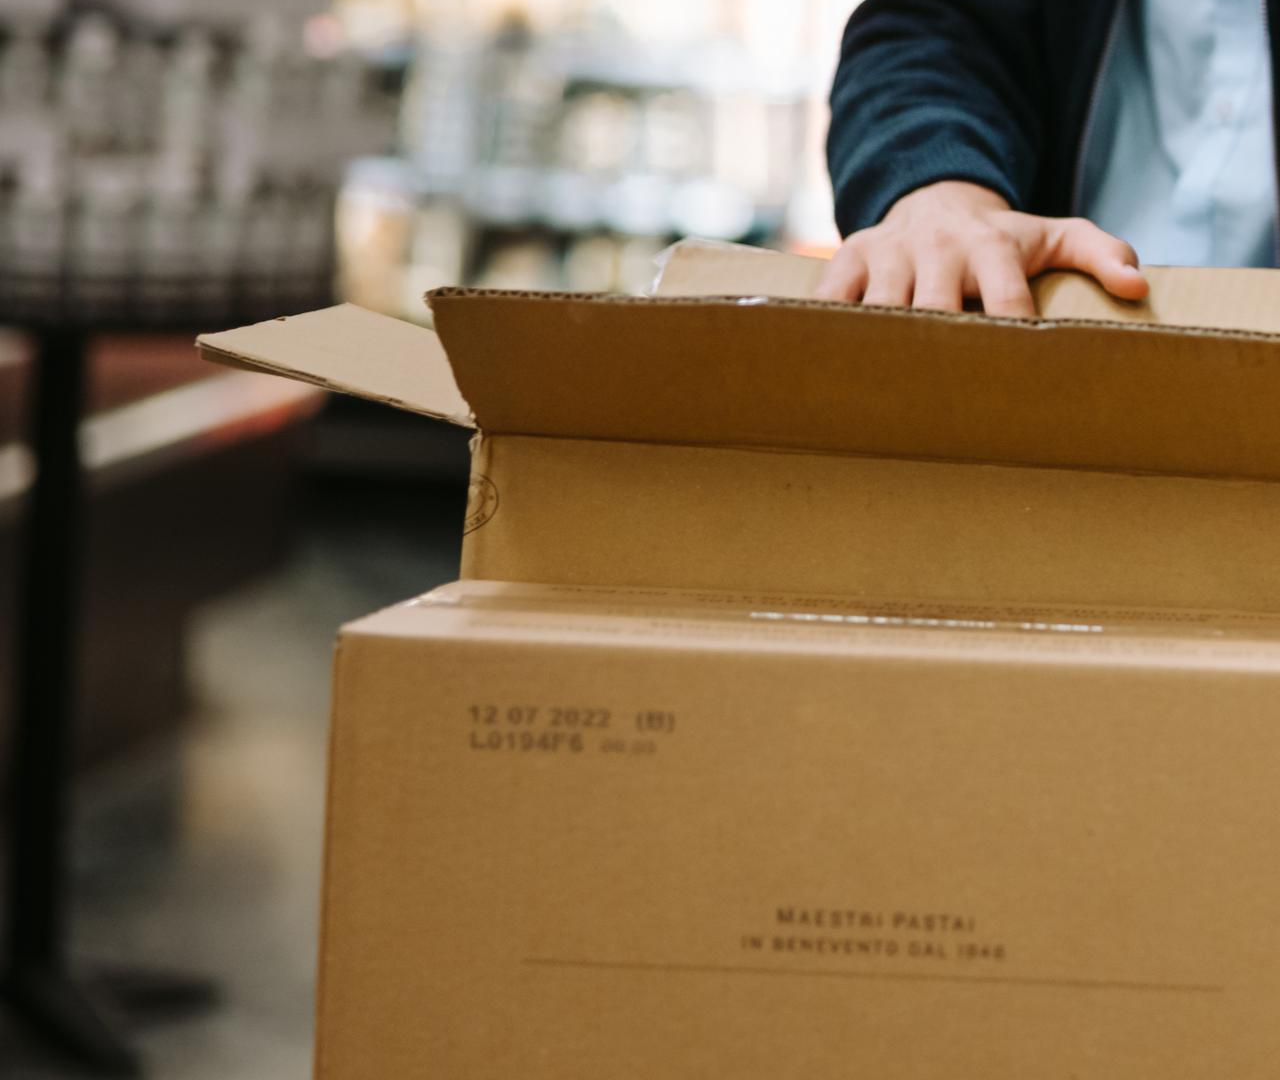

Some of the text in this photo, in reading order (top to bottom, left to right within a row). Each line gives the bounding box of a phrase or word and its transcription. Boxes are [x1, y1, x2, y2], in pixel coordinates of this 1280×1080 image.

[468, 705, 498, 724] 12
[506, 705, 538, 725] 07
[548, 707, 612, 728] 2022
[776, 908, 975, 933] MAESTRI PASTAI
[772, 936, 898, 957] BENEVENTO
